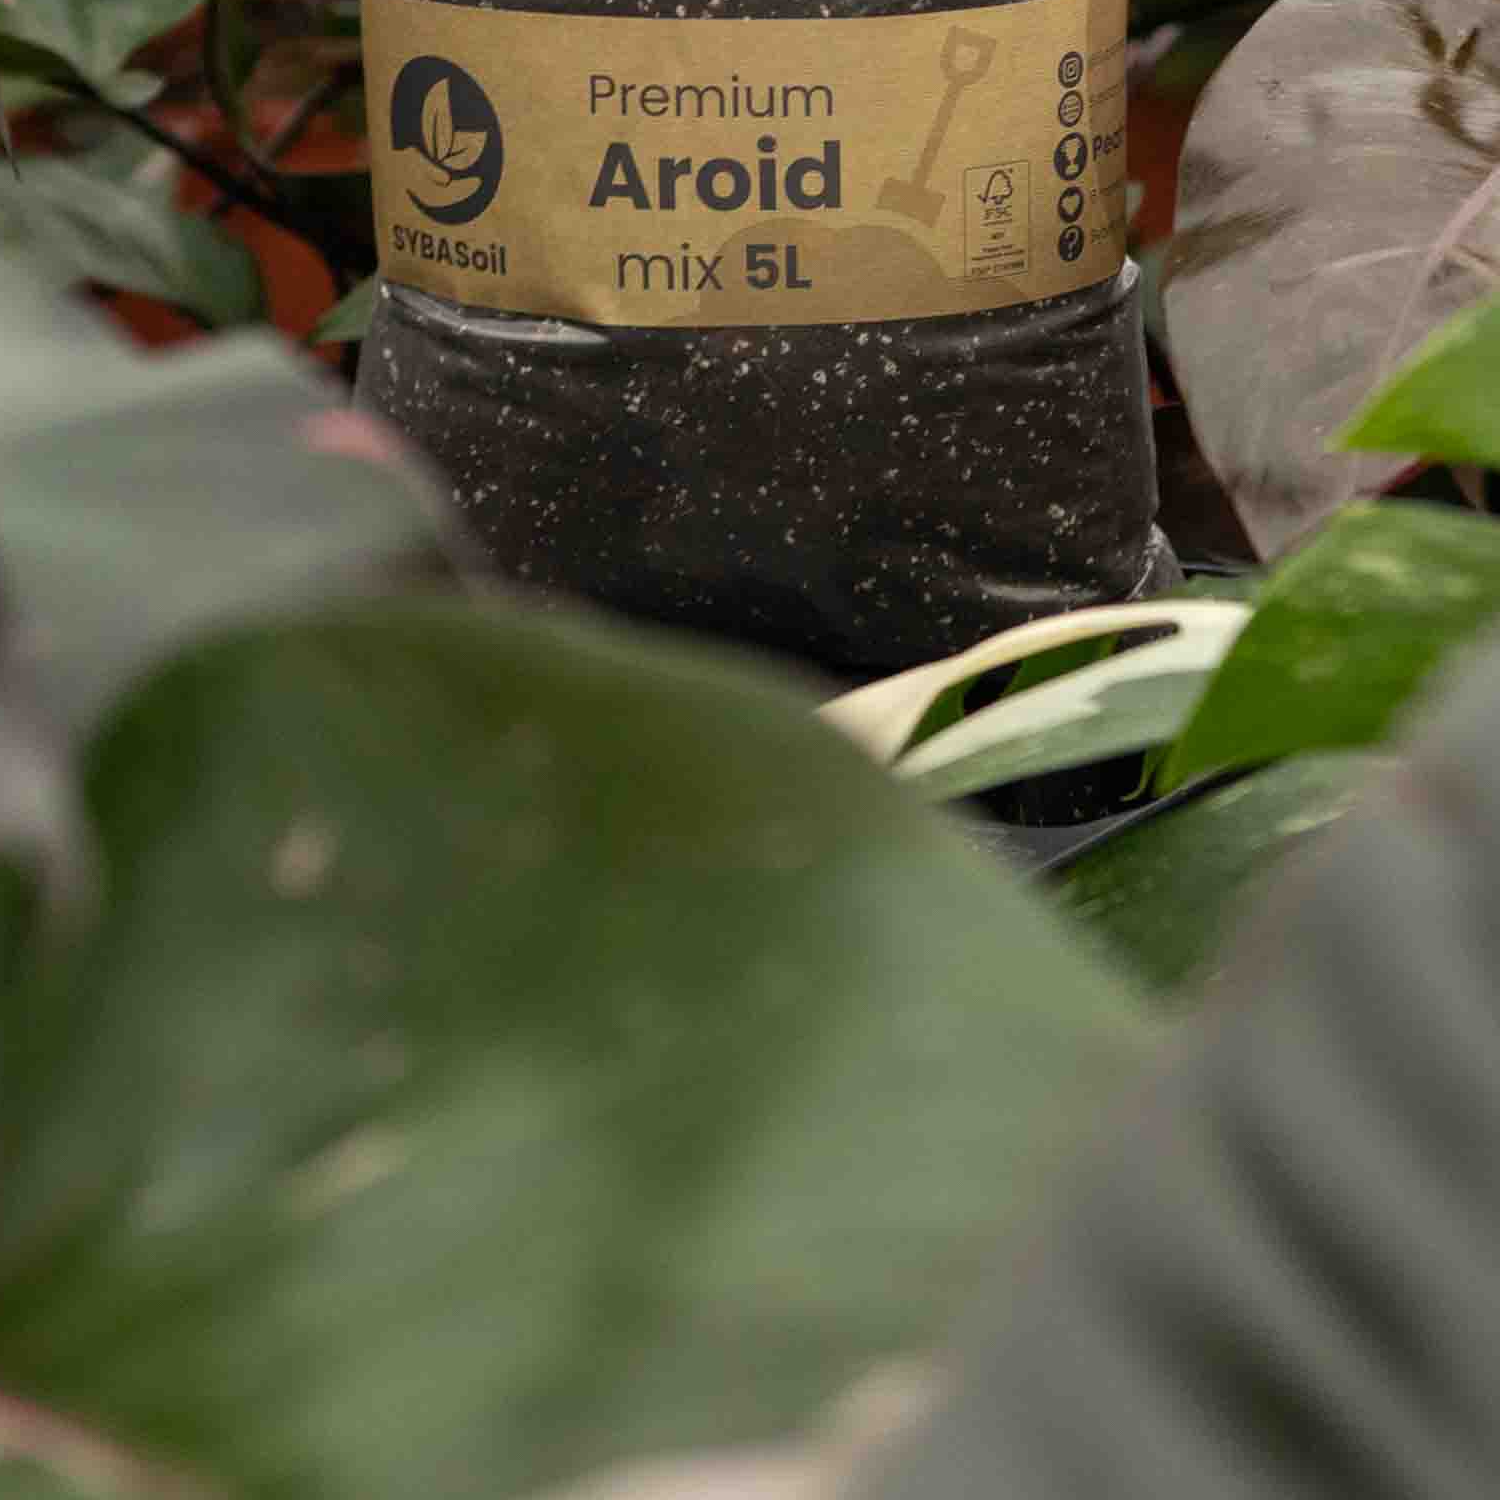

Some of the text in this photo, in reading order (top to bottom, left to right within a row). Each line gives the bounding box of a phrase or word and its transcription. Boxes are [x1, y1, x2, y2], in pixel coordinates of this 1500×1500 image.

[589, 73, 834, 118] Premium
[587, 135, 842, 212] Aroid
[391, 226, 508, 276] SYBASoil
[617, 242, 813, 292] mix 5L
